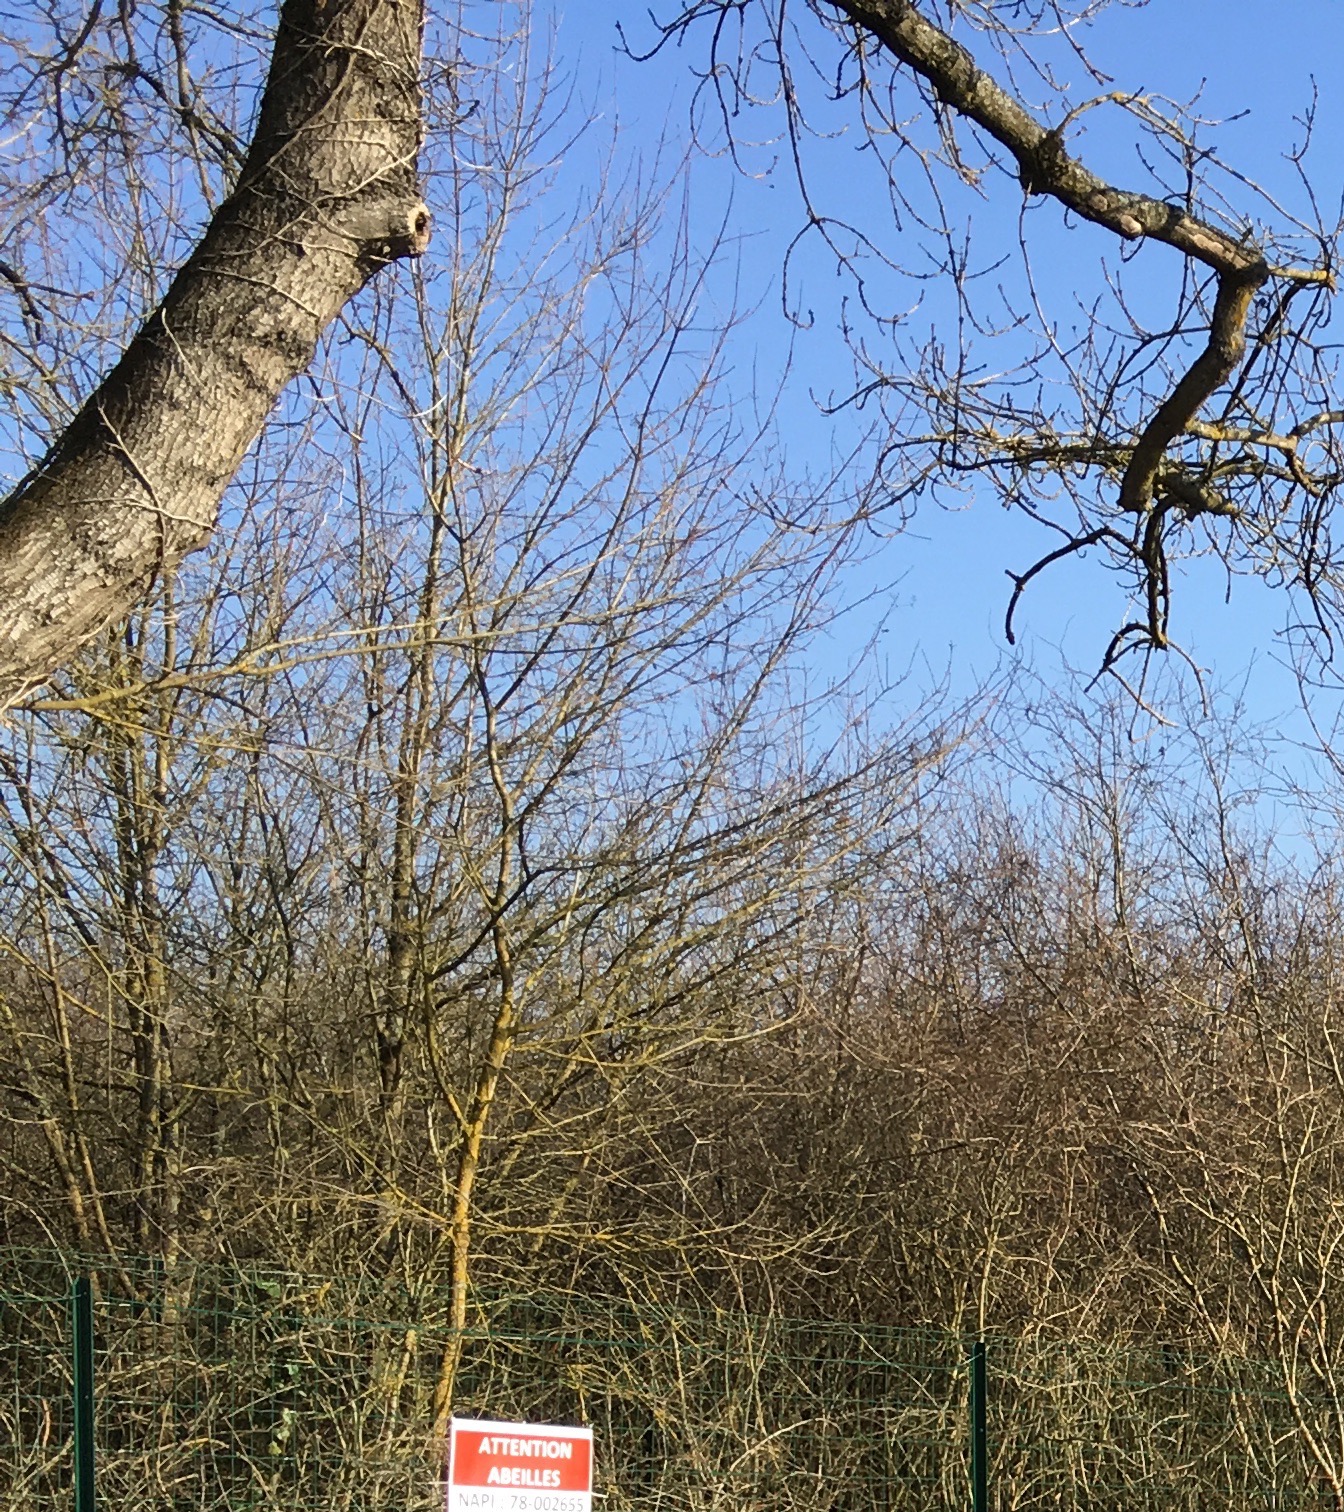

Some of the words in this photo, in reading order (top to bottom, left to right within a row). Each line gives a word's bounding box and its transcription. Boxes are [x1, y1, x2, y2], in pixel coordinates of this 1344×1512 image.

[478, 1436, 573, 1459] ATTENTION
[487, 1466, 561, 1487] ABEILLES
[459, 1493, 495, 1509] NAPI
[510, 1495, 584, 1512] 78-002655
